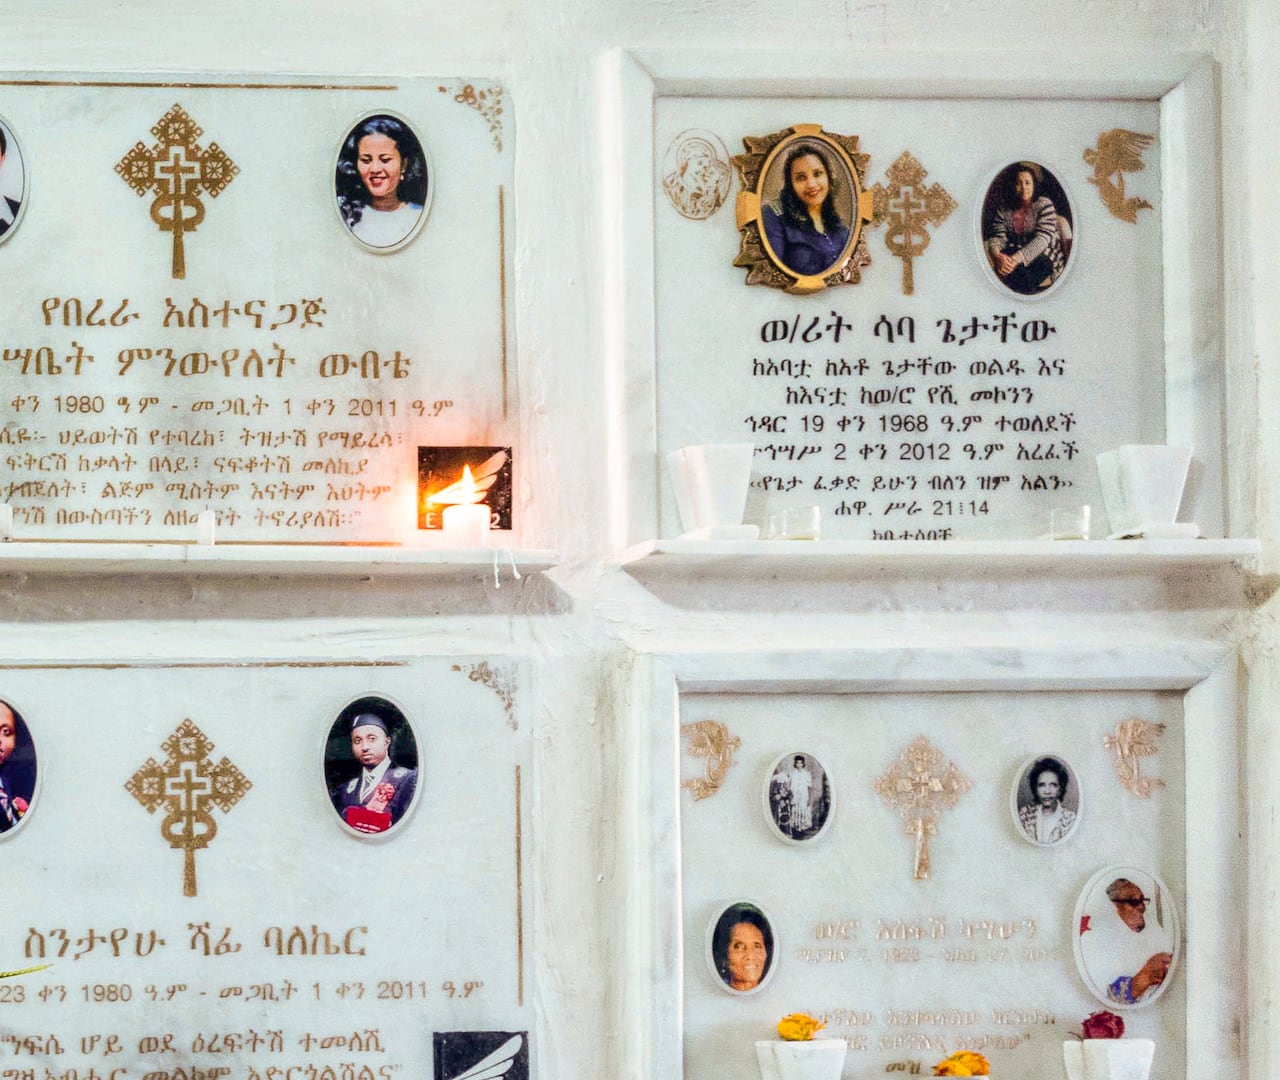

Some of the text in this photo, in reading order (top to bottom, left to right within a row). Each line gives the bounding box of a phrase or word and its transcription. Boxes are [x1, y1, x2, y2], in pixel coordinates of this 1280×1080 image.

[41, 297, 327, 331] የበረራ አስተናጋጅ
[760, 310, 1057, 346] ወ/ሪት ሳባ ጌታቸው
[117, 342, 296, 378] ምንውየለት
[318, 350, 411, 380] ውበቴ
[825, 358, 870, 377] ከአቶ
[881, 357, 957, 378] ጌታቸው
[969, 358, 1026, 377] ወልዱ
[1037, 357, 1066, 376] እና
[860, 386, 916, 406] ከወ/ሮ
[927, 384, 958, 406] የሺ
[801, 414, 825, 433] 19
[836, 415, 866, 433] ቀን
[879, 414, 929, 433] 1968
[940, 414, 983, 433] ዓ.ም
[994, 412, 1077, 433] ተወለደች
[833, 440, 1079, 461] 2 ቀን 2012 ዓ.ም አረፈች
[813, 475, 860, 491] ፈቃድ
[871, 475, 918, 493] ይሁን
[927, 475, 967, 491] ብለን
[977, 475, 1011, 491] ዝም
[883, 500, 923, 516] ሥራ
[24, 927, 166, 960] ስንታየሁ
